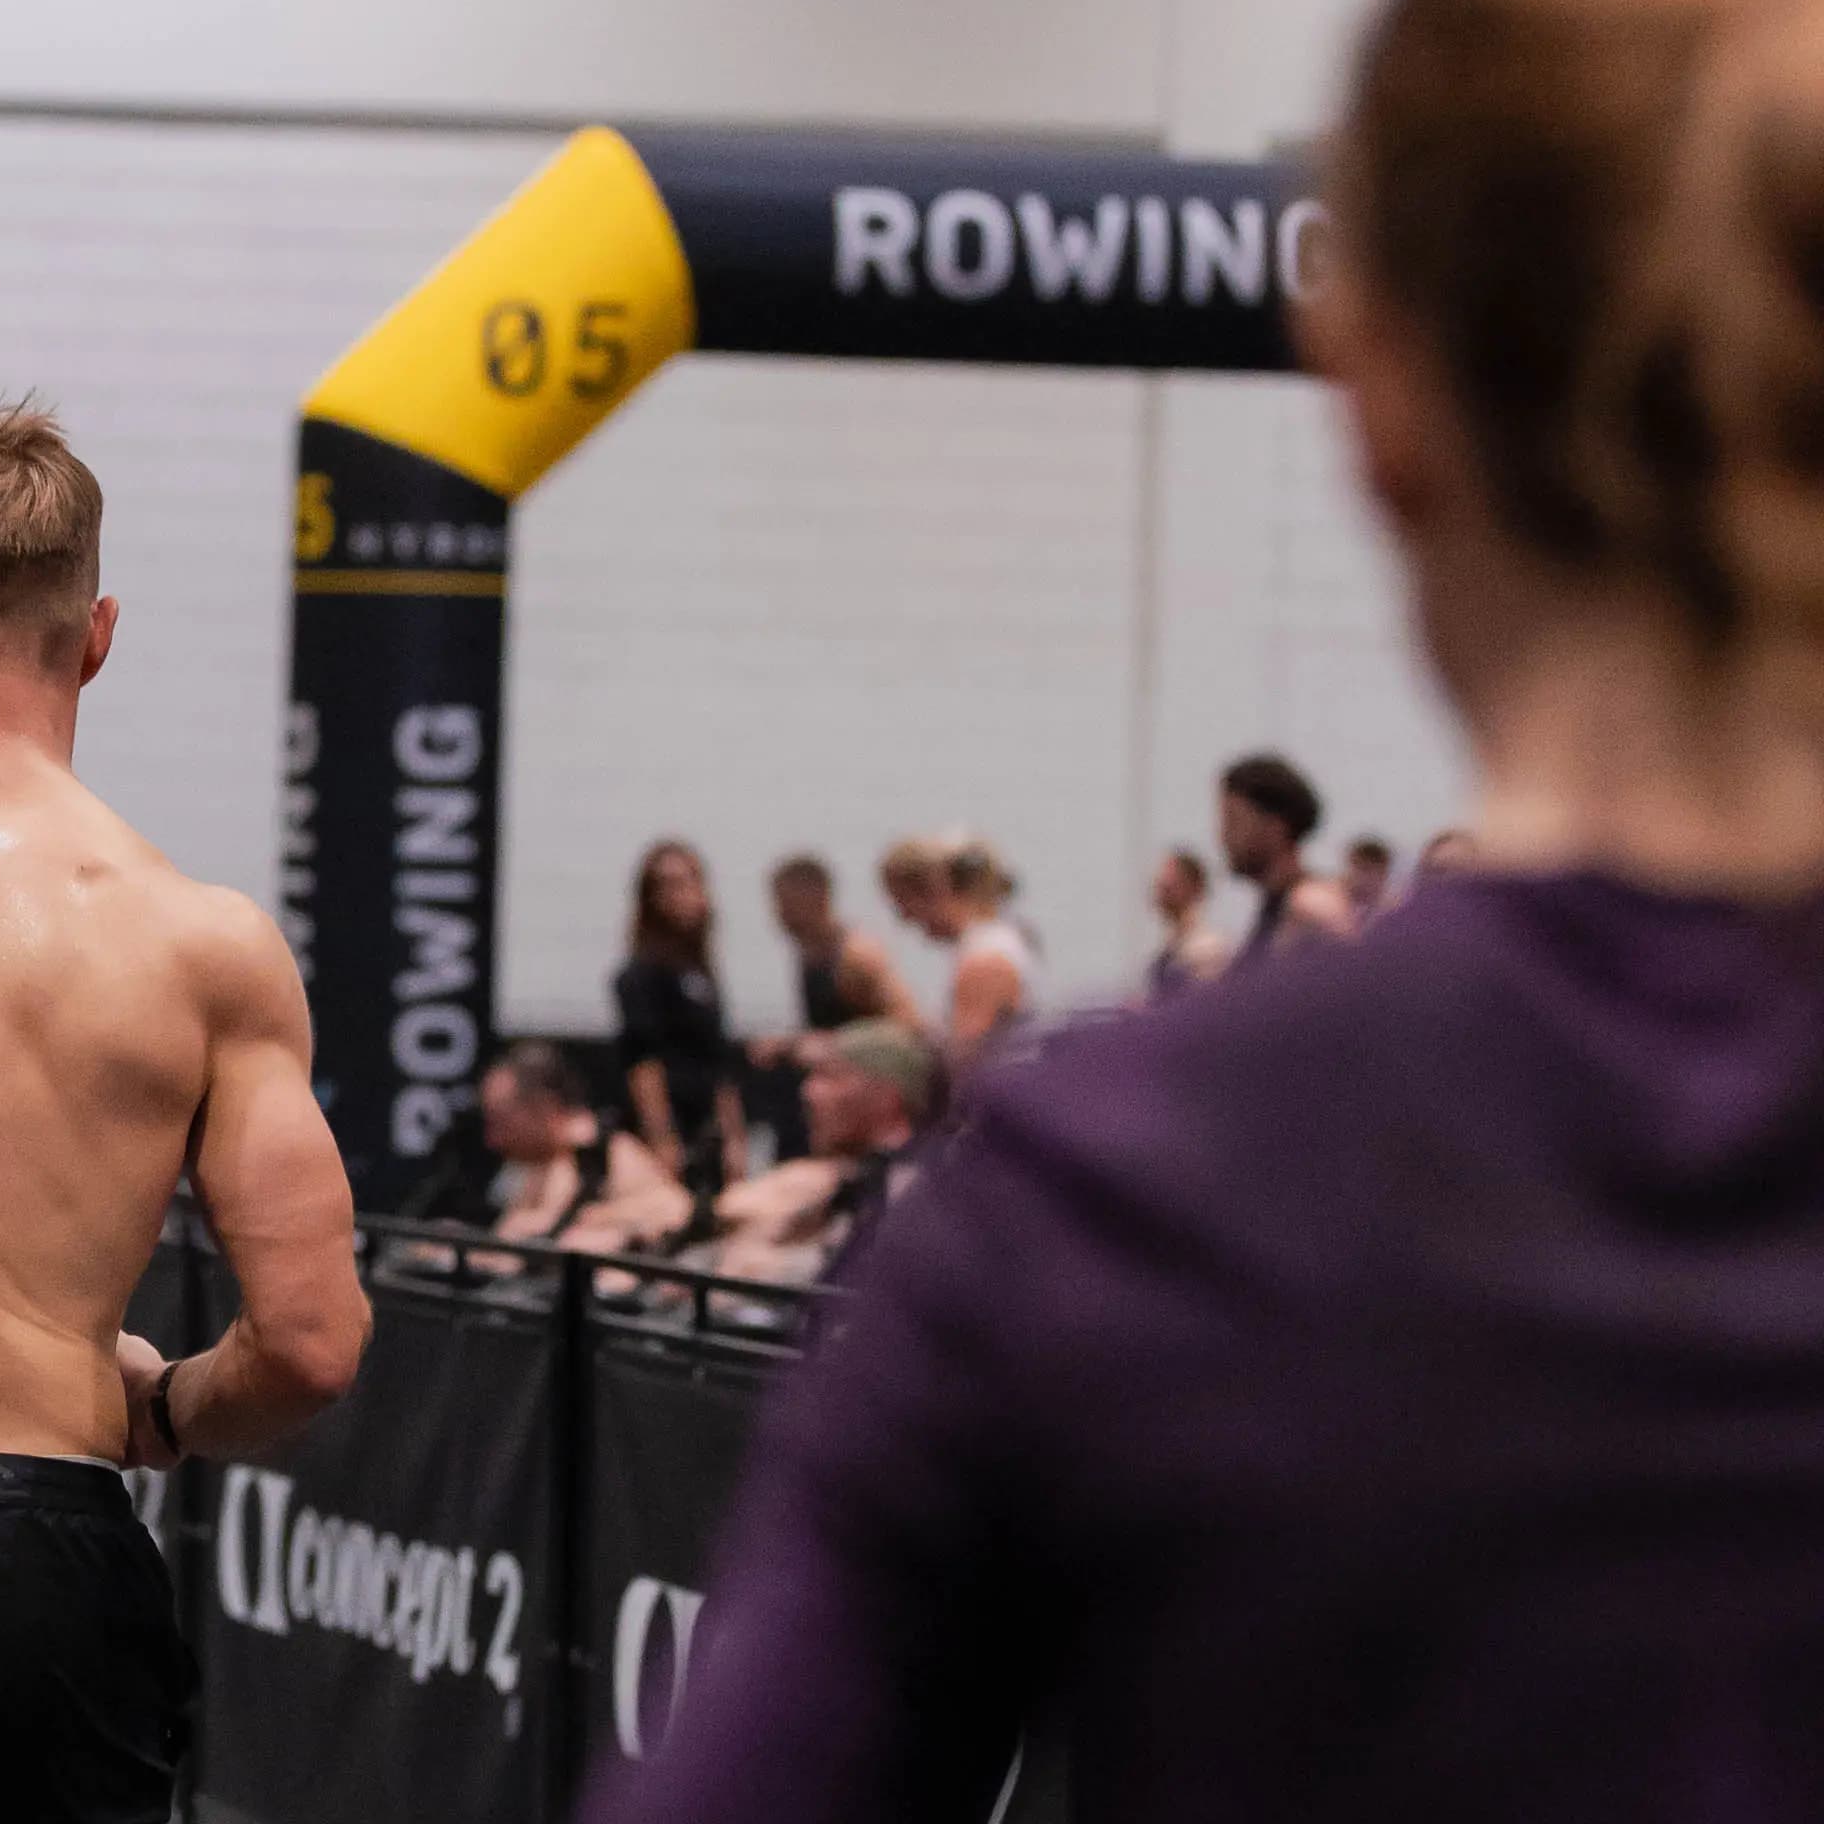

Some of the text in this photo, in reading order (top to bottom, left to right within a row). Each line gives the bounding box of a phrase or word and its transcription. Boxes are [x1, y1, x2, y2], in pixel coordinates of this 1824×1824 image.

[480, 296, 629, 398] 05
[390, 701, 482, 1158] ROWING
[484, 1551, 523, 1694] 2
